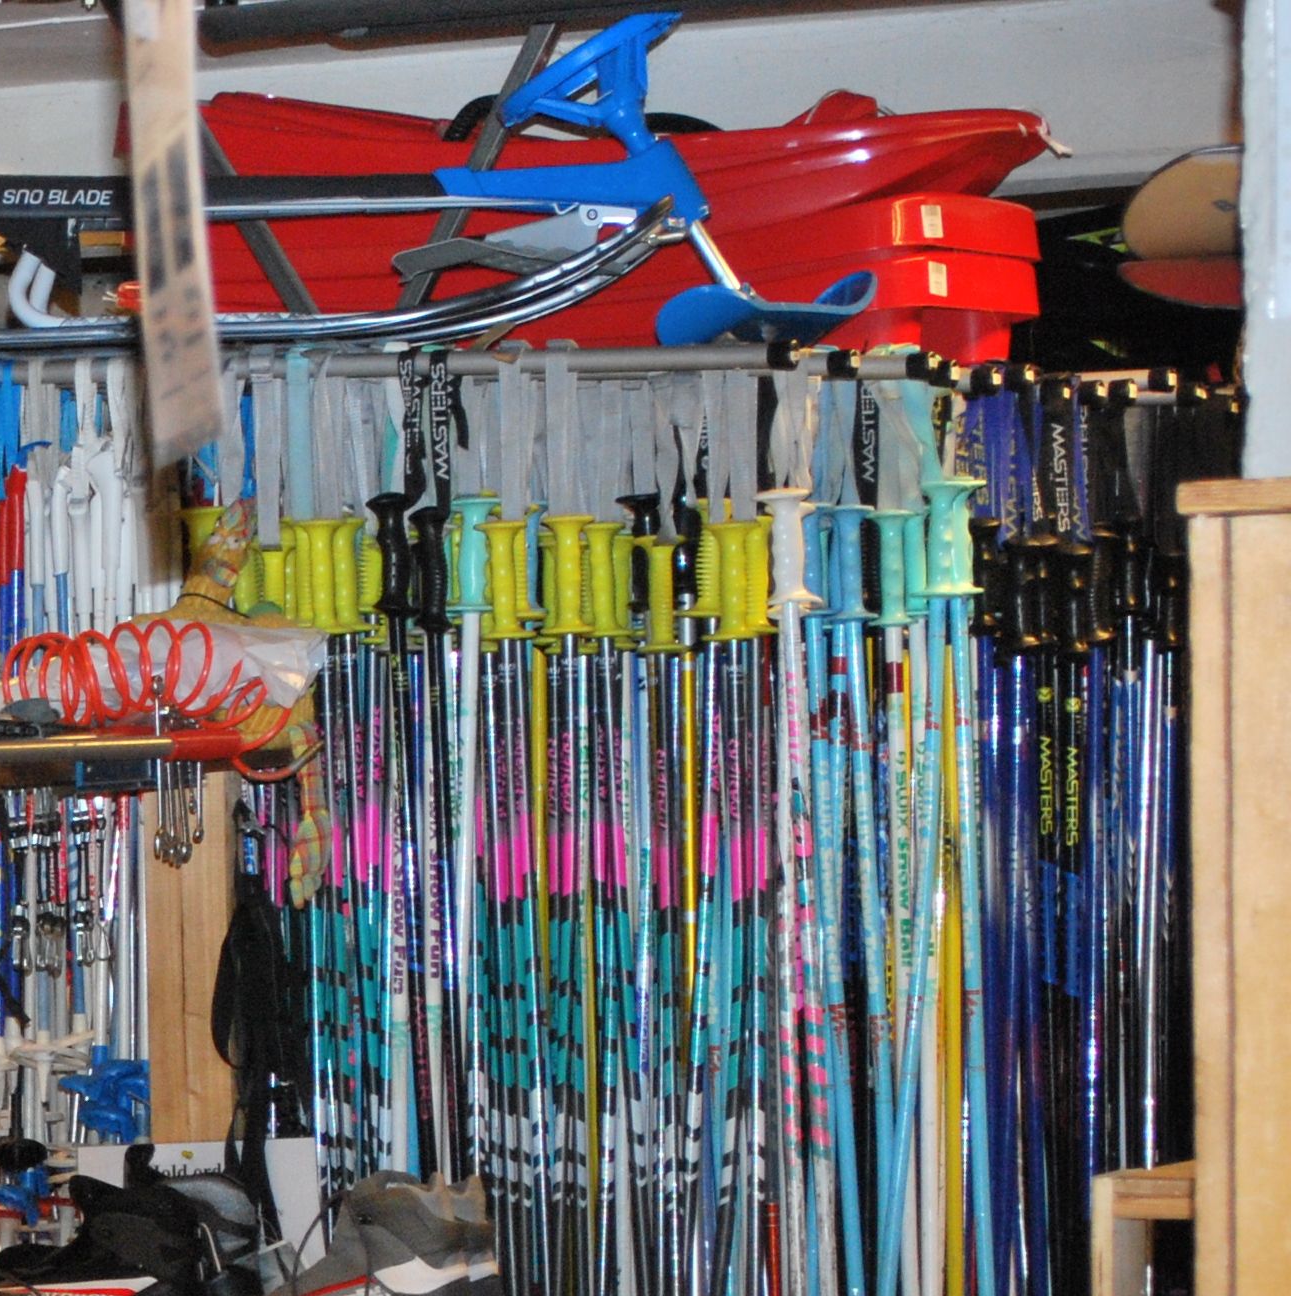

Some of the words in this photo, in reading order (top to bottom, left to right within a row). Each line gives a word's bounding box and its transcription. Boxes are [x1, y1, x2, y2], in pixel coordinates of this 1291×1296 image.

[47, 189, 114, 206] BLADE
[430, 361, 450, 480] MASTERS
[861, 374, 876, 482] MASTER
[1051, 423, 1071, 533] MASTERS
[1040, 735, 1053, 836] MASTERS
[1066, 746, 1082, 847] MASTERS
